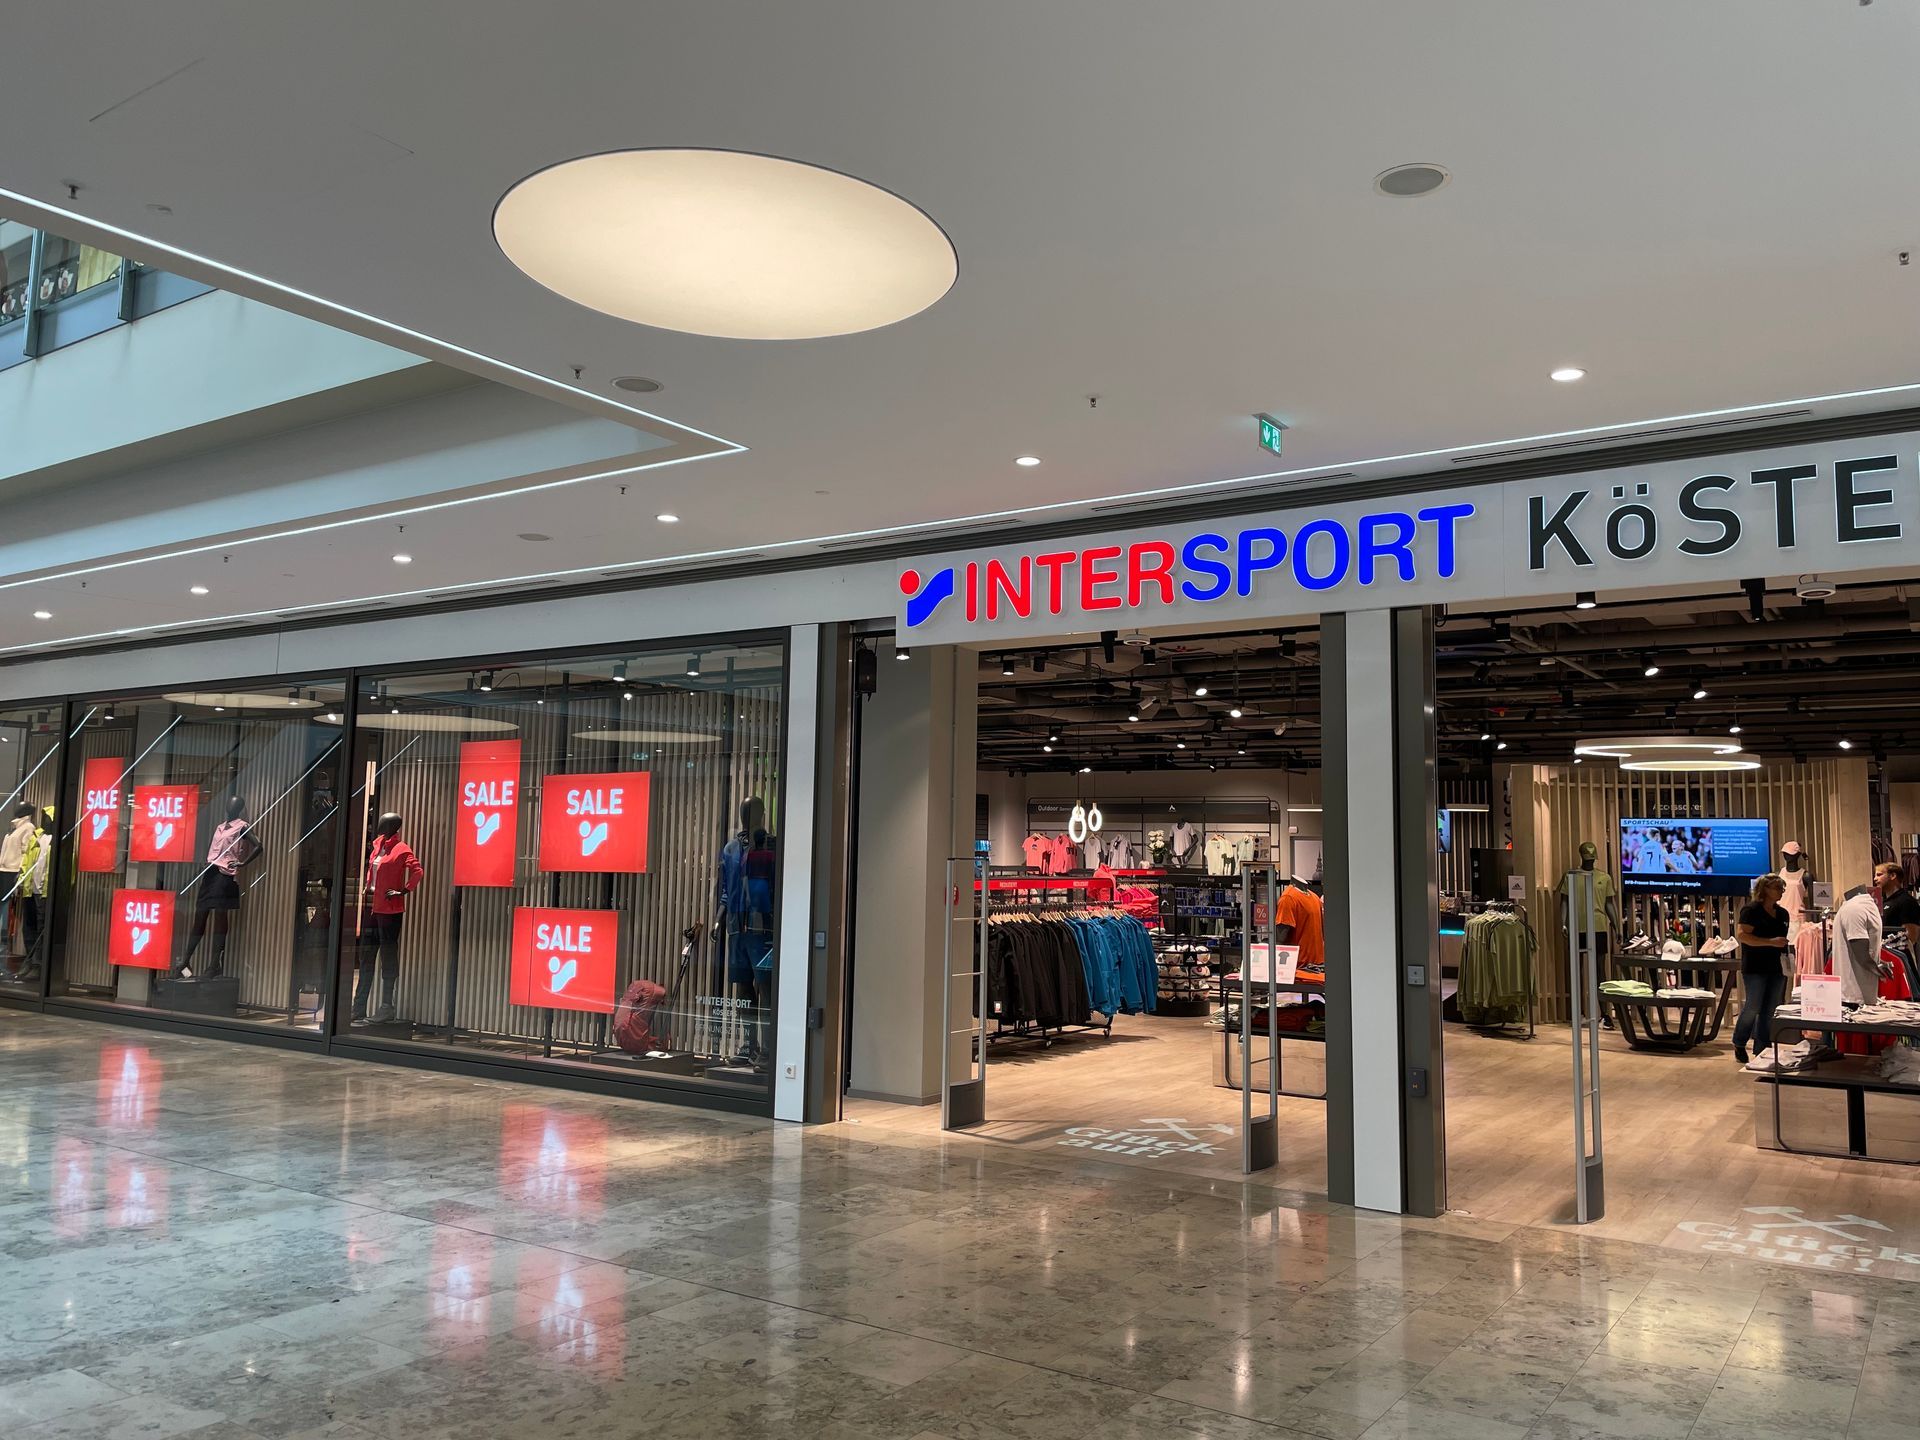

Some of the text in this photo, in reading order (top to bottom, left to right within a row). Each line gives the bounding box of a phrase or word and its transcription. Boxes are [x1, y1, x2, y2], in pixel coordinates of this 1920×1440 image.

[1528, 453, 1920, 571] KöSTE
[965, 502, 1475, 622] INTERSPORT
[86, 789, 119, 810] SALE
[148, 797, 184, 818] SALE
[464, 780, 515, 807] SALE
[566, 788, 624, 815] SALE
[125, 902, 160, 924] SALE
[536, 924, 592, 953] SALE
[1057, 1138, 1176, 1158] auf!
[1064, 1126, 1229, 1155] Glück
[1676, 1221, 1920, 1264] Glück
[1701, 1241, 1875, 1272] auf!
